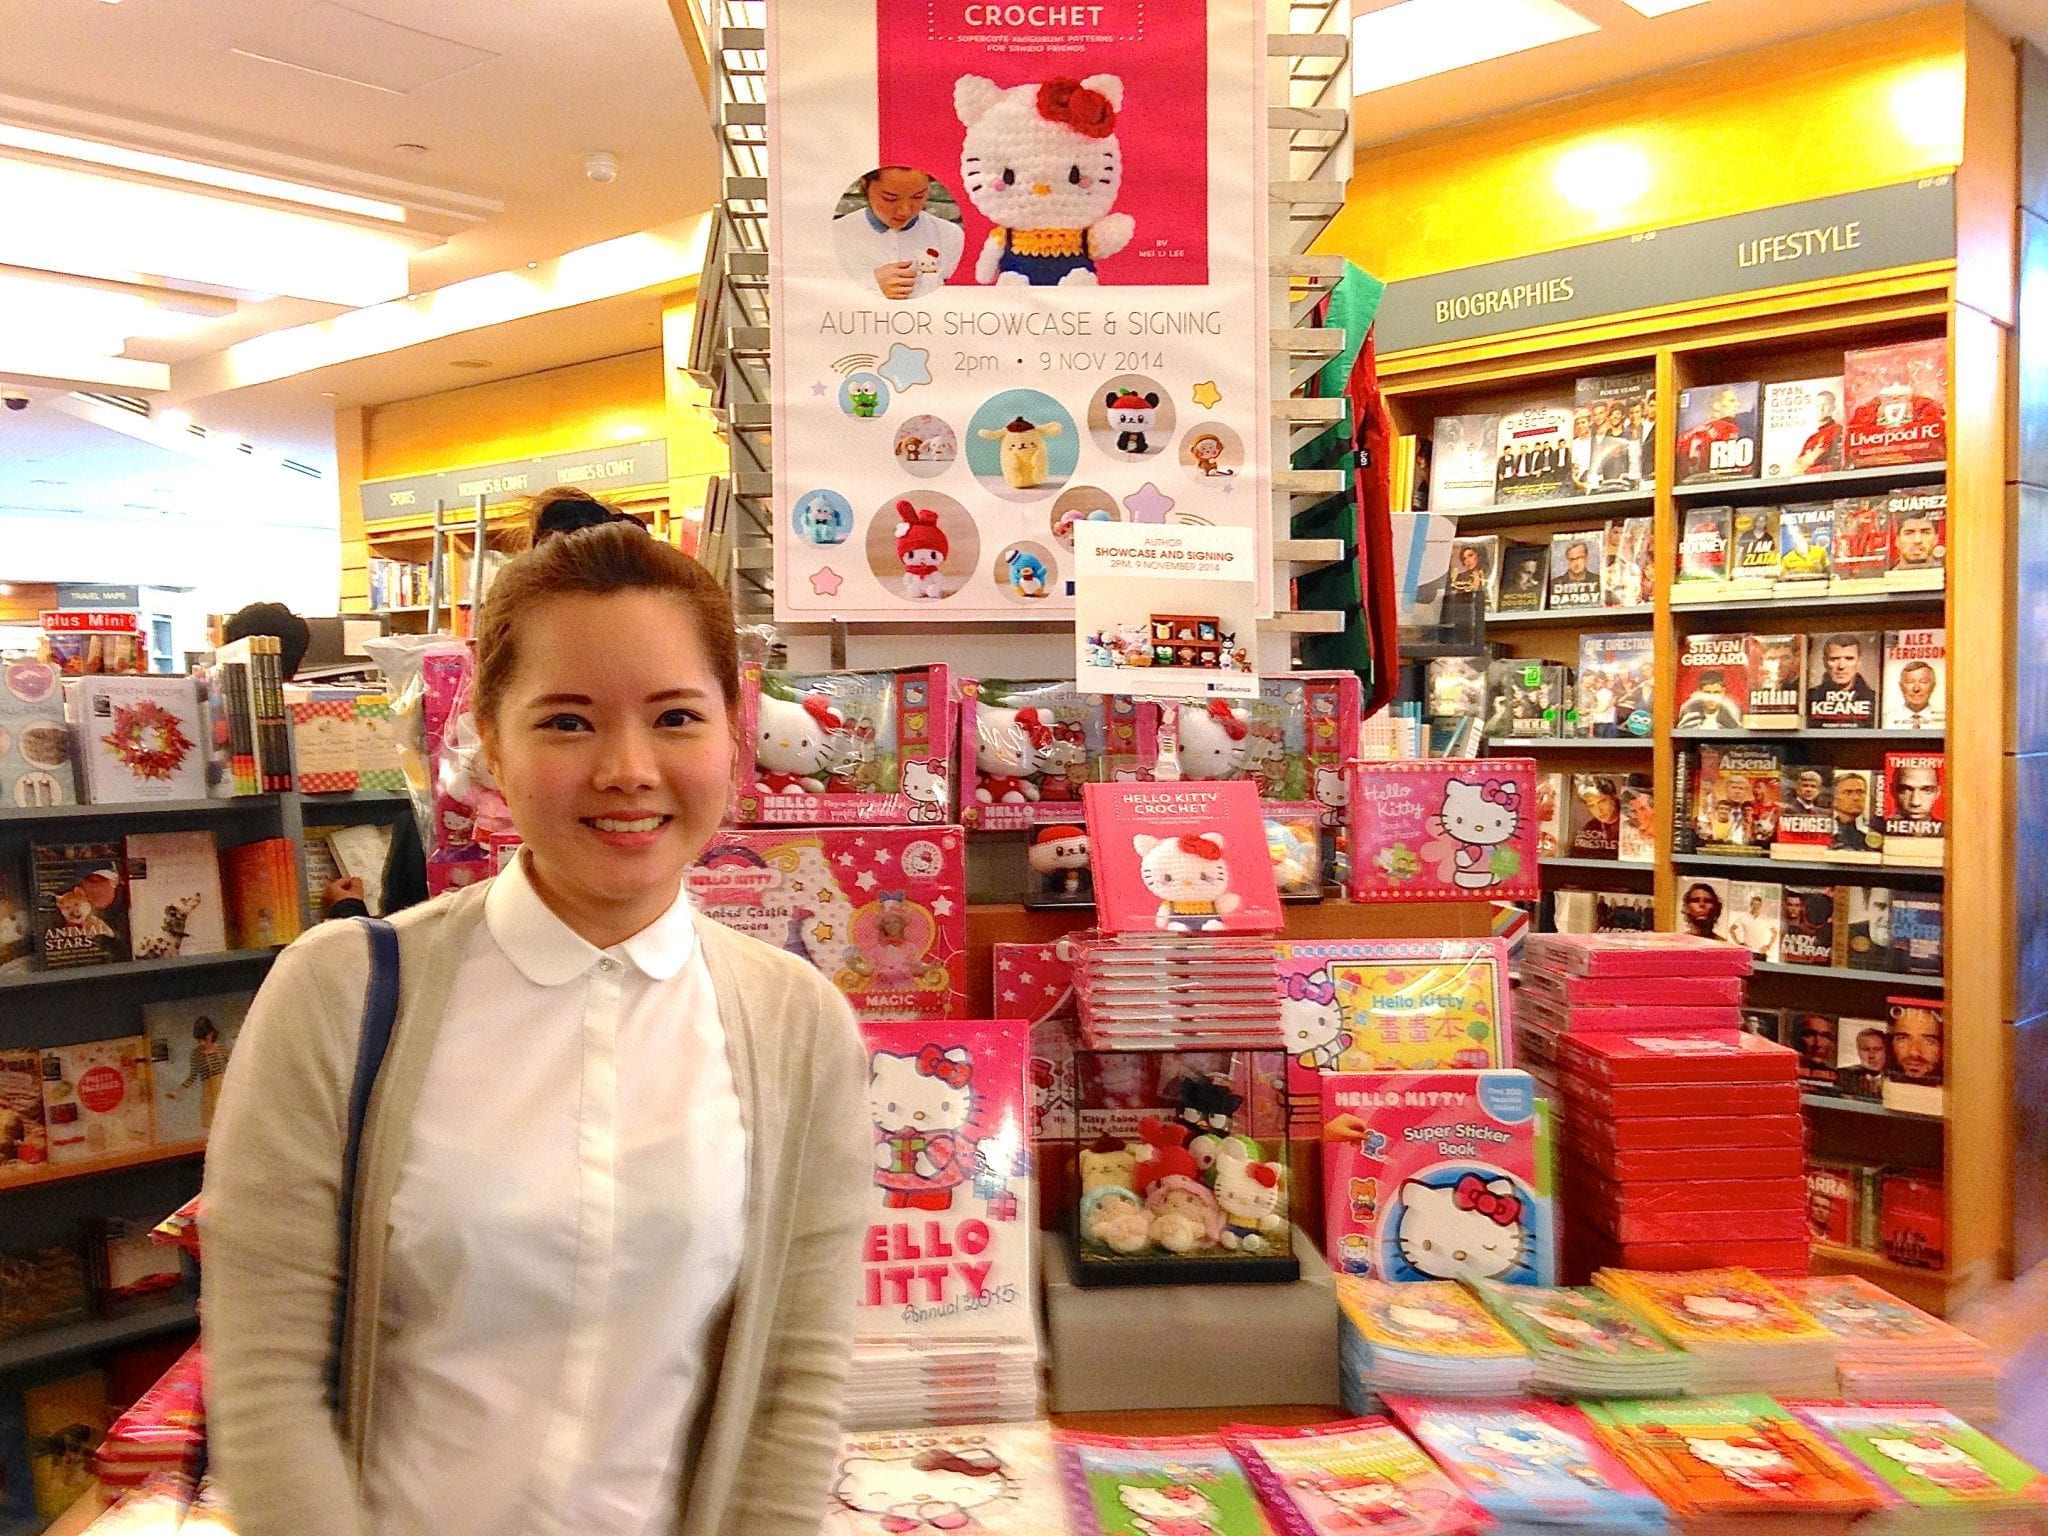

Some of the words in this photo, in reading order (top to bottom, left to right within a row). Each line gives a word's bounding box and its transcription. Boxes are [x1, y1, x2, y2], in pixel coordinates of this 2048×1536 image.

[964, 4, 1104, 26] CROCHET
[1047, 44, 1086, 52] FRIENDS
[1738, 222, 1861, 268] LIFESTYLE
[1169, 250, 1185, 258] LEE
[1435, 276, 1574, 323] BIOGRAPHIES
[819, 311, 932, 336] AUTHOR
[944, 311, 1092, 336] SHOWCASE
[1103, 311, 1116, 336] &
[1129, 311, 1221, 336] SIGNING
[953, 351, 999, 375] 2pm
[1039, 352, 1051, 371] 9
[1059, 352, 1106, 371] NOV
[1115, 352, 1164, 371] 2014
[1772, 386, 1803, 396] RYAN
[1771, 394, 1811, 408] GIGGS
[1850, 428, 1919, 447] Liverpool
[1920, 422, 1941, 440] FC
[1709, 437, 1754, 469] RIO
[1888, 495, 1947, 512] SUAREZ
[1780, 511, 1835, 526] NEYMAR
[1144, 538, 1182, 546] AUTHOR
[1095, 547, 1157, 559] SHOWCASE
[1159, 550, 1184, 560] AND
[1187, 551, 1235, 562] SIGNING
[1143, 561, 1196, 572] NOVEMBER
[1198, 563, 1221, 572] 2014
[1553, 581, 1597, 593] DIRTY
[1551, 592, 1601, 604] DADDY
[88, 613, 125, 628] Mini
[1905, 633, 1933, 645] ALEX
[1689, 641, 1740, 655] STEVEN
[1681, 652, 1750, 667] GERRARD
[1750, 689, 1797, 706] GERRARD
[1826, 691, 1856, 703] ROY
[1811, 701, 1871, 716] KEANE
[1719, 755, 1778, 771] Arsenal
[1889, 756, 1945, 769] THIERRY
[1122, 794, 1171, 804] HELLO
[1176, 793, 1218, 803] KITTY
[1363, 782, 1412, 801] Hello
[763, 795, 819, 808] HELLO
[1134, 803, 1206, 814] CROCHET
[763, 808, 819, 821] KITTY
[984, 806, 1035, 818] HELLO
[1377, 801, 1426, 819] Kitty
[1779, 816, 1833, 834] WENGER
[1886, 820, 1942, 835] HENRY
[747, 907, 788, 917] Castle
[44, 926, 107, 939] ANIMAL
[1783, 933, 1815, 947] ANDY
[44, 937, 93, 951] STARS
[1781, 944, 1831, 957] MURRAY
[865, 994, 915, 1005] MAGIC
[1373, 995, 1414, 1008] Hello
[1419, 994, 1465, 1010] Kitty
[1334, 1091, 1400, 1107] HELLO
[1405, 1091, 1468, 1106] KITTY
[1403, 1125, 1451, 1141] Super
[1456, 1124, 1511, 1143] Sticker
[1439, 1142, 1476, 1156] Book
[862, 1218, 990, 1262] ELLO
[858, 1260, 993, 1306] ITTY
[901, 1294, 959, 1324] Annual
[963, 1283, 1017, 1312] 2015
